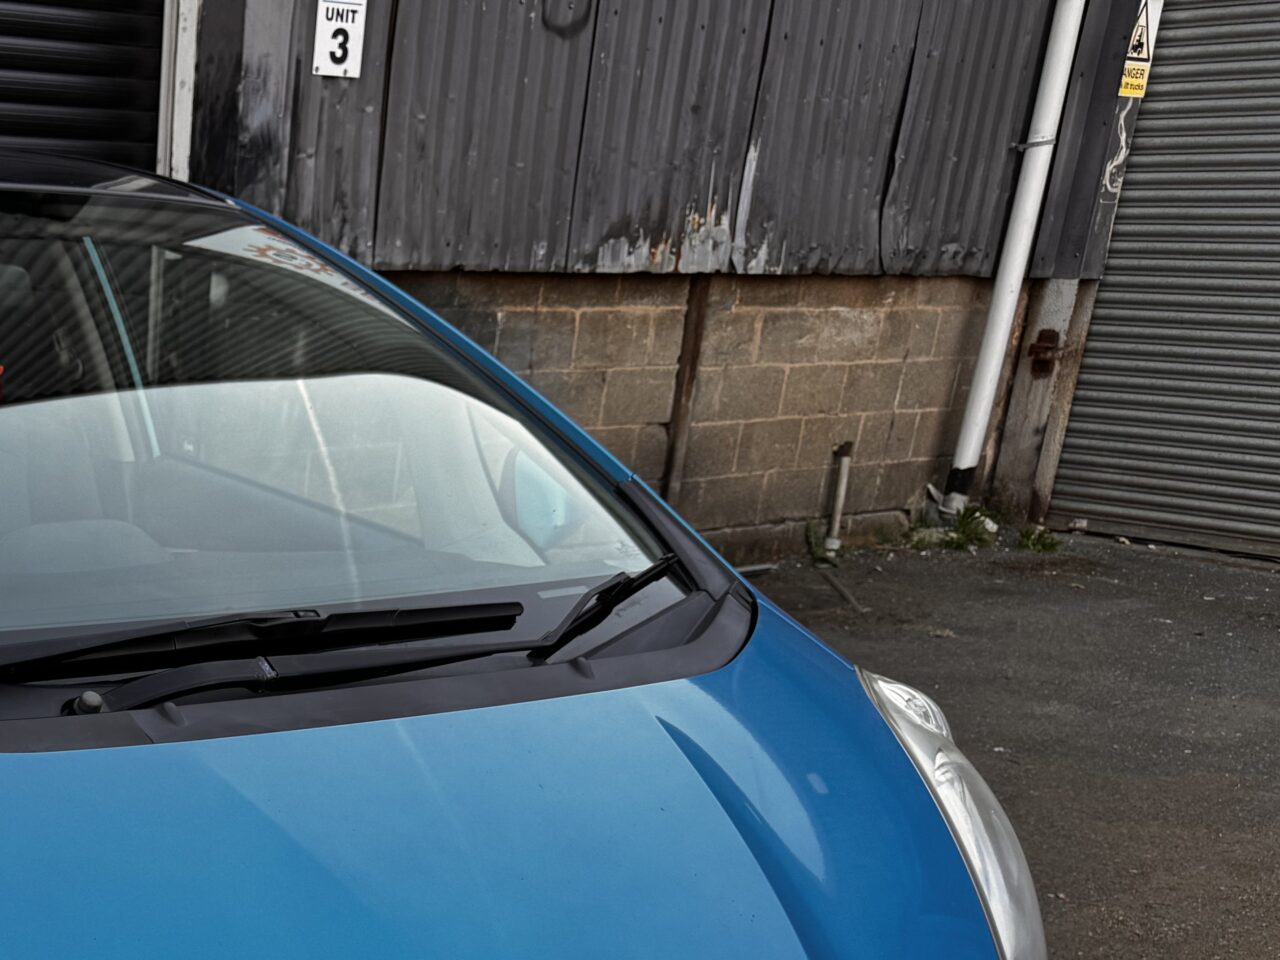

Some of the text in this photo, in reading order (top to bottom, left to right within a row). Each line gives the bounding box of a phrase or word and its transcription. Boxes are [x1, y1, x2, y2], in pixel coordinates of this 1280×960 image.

[326, 7, 358, 23] UNIT
[329, 27, 349, 65] 3
[1123, 67, 1145, 80] ANGER
